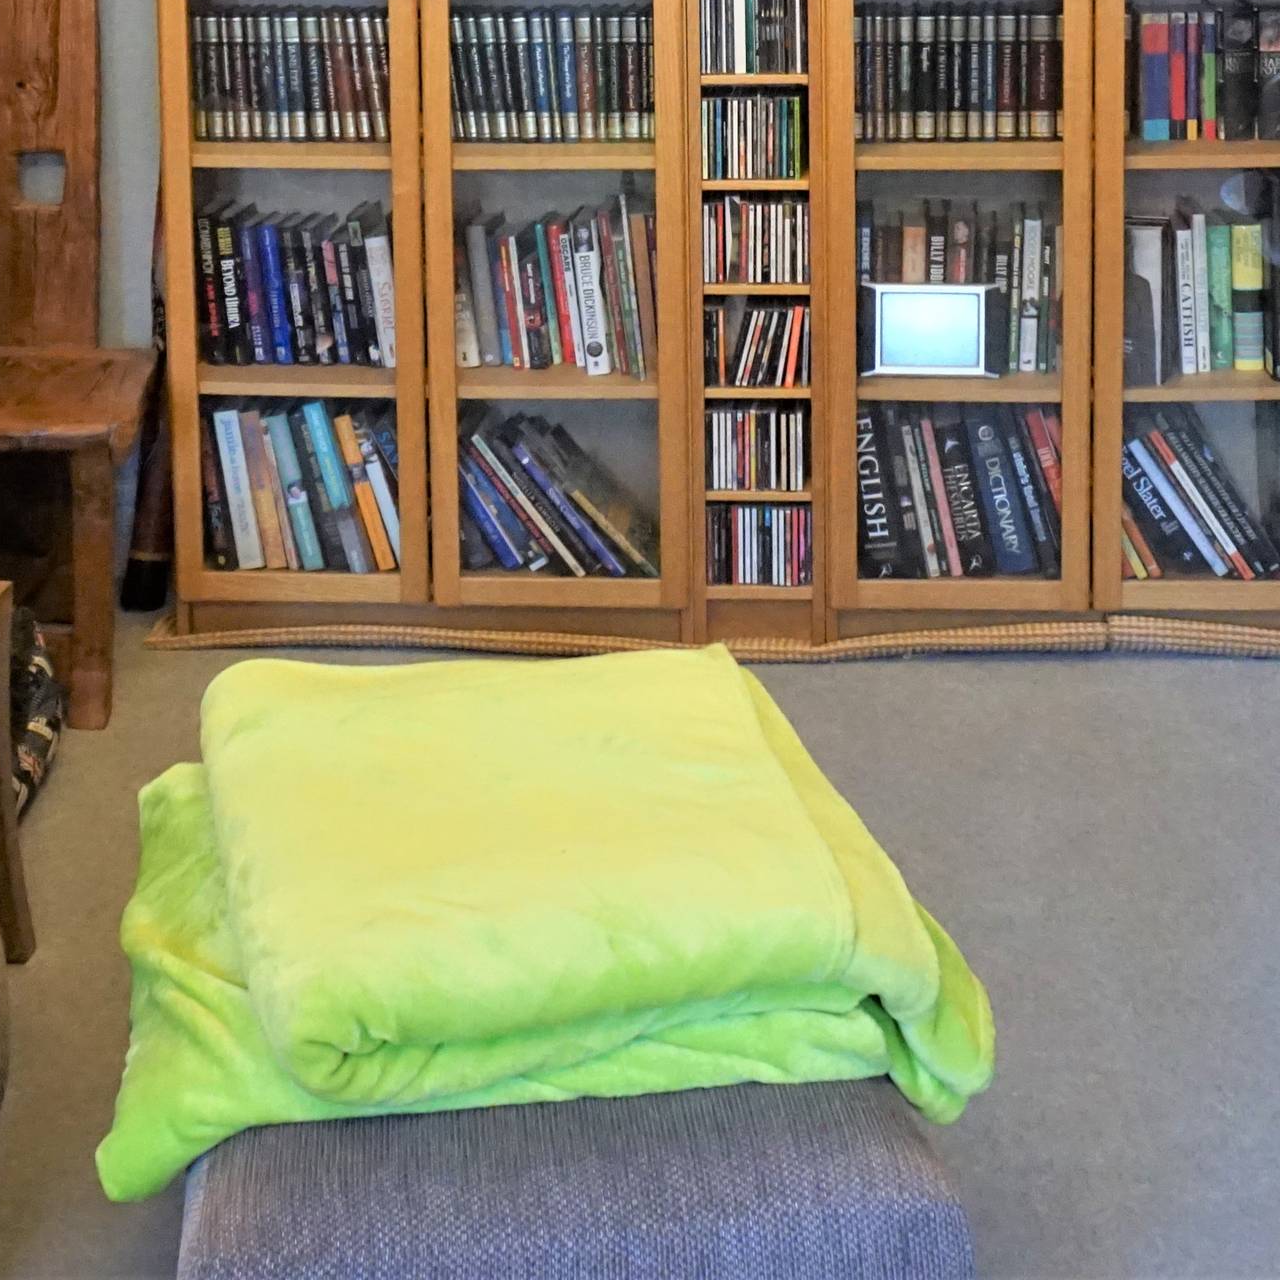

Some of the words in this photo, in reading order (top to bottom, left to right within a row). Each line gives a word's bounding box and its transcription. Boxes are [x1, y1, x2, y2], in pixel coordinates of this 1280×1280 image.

[579, 255, 593, 287] BRUCE
[930, 236, 944, 260] BILLY
[220, 259, 236, 296] BEYOND
[1026, 257, 1038, 291] MOORE
[582, 289, 599, 340] DICKINSON
[1182, 282, 1195, 348] CATFISH
[857, 417, 889, 538] ENGLISH
[953, 463, 981, 540] ENCARTA
[1133, 476, 1167, 520] Slater
[943, 467, 969, 542] THESAURUS
[985, 457, 1022, 554] DICTIONARY
